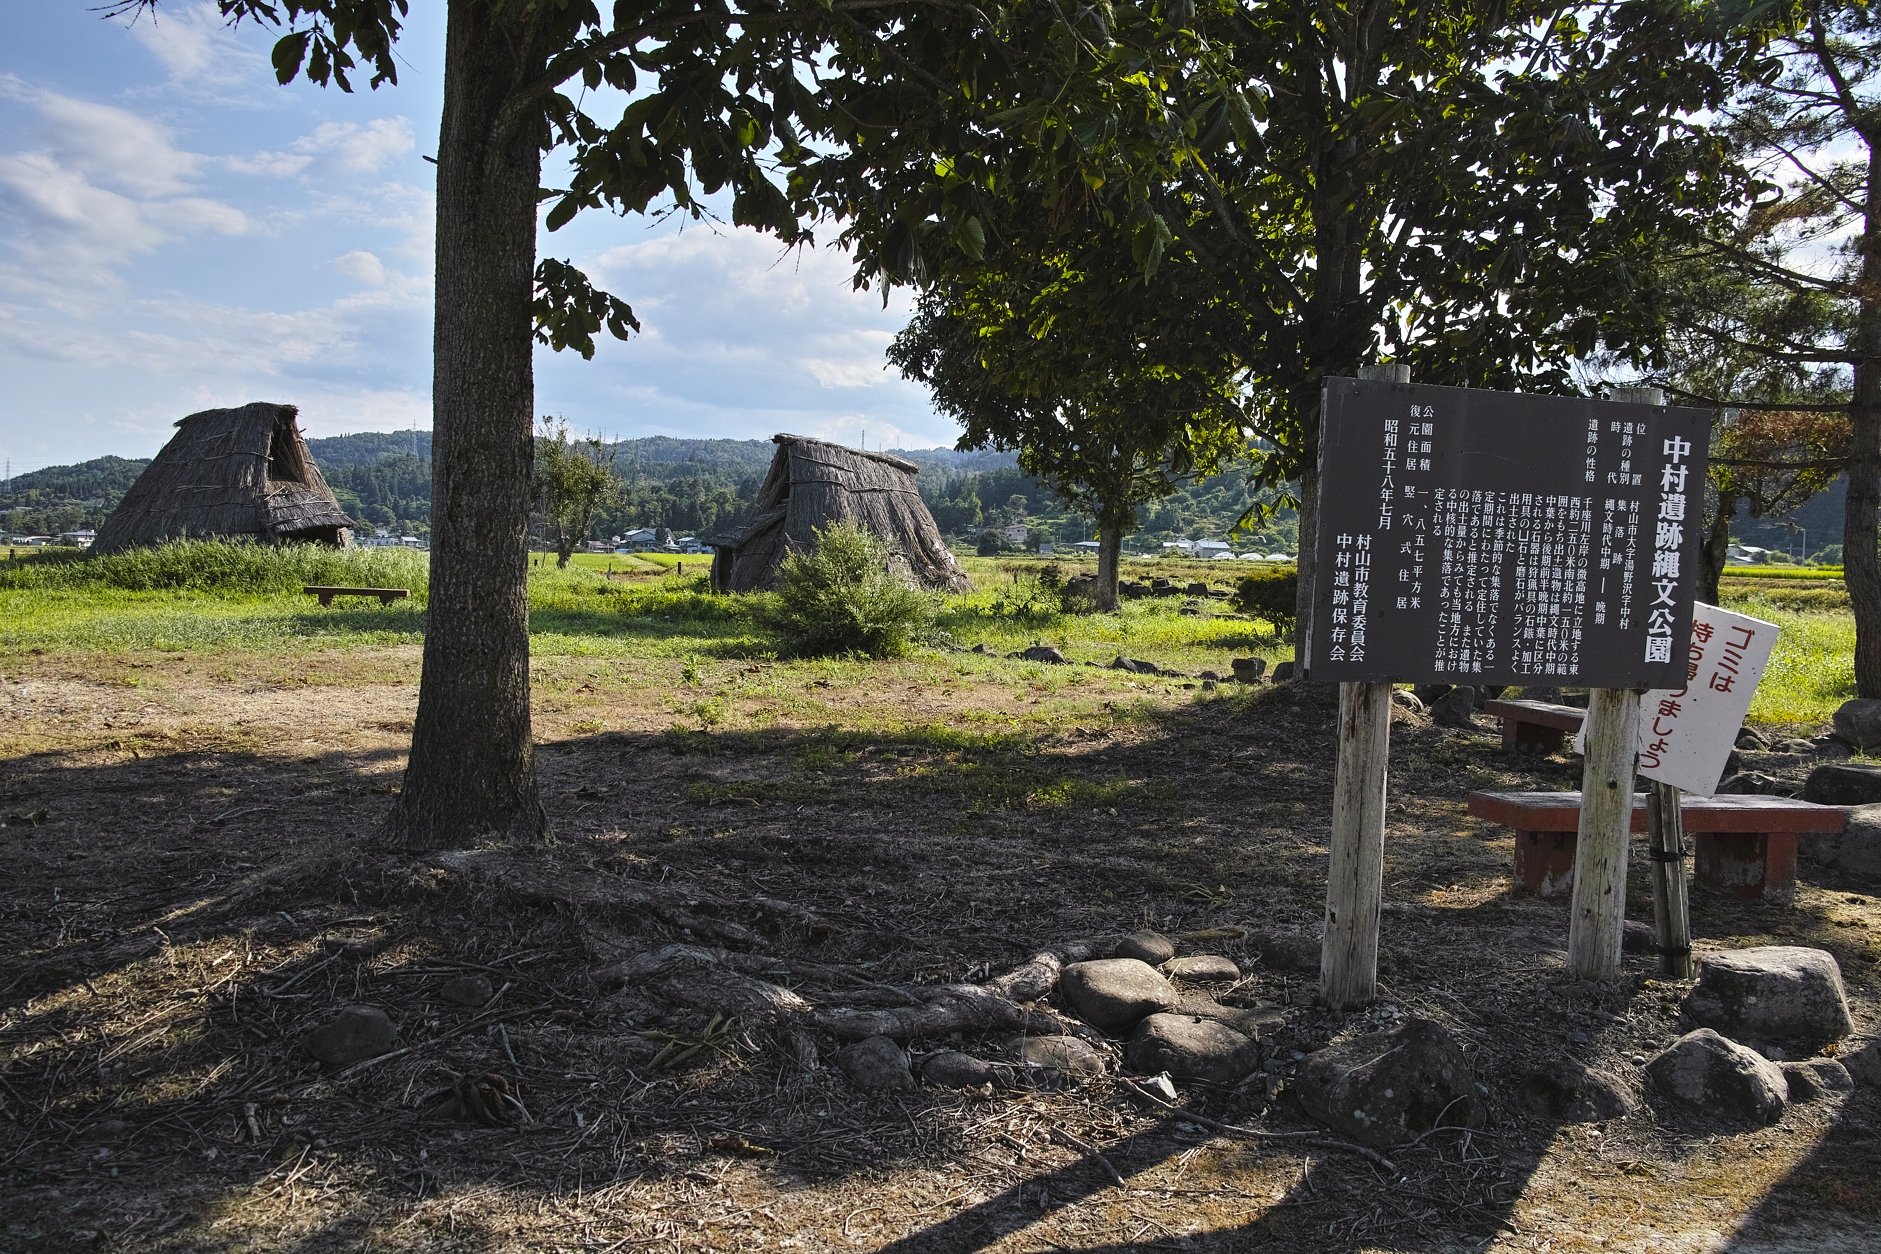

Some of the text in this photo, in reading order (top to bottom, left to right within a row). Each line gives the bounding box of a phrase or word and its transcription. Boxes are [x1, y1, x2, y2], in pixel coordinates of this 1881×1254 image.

[1406, 405, 1420, 470] 復元住居
[1420, 406, 1434, 471] 公園面積
[1585, 419, 1598, 482] 遺跡の性格
[1619, 422, 1633, 484] 遺跡の種別
[1378, 419, 1398, 529] 昭和五十八年七月
[1433, 488, 1445, 535] 定される
[1506, 493, 1519, 552] 出土された
[1619, 501, 1640, 629] 村山市大字湯野沢字中村
[1645, 436, 1691, 663] 中村遺跡縄文公園
[1330, 533, 1352, 661] 中村遺跡保存会
[1350, 534, 1372, 662] 村山市教育委員会
[1709, 625, 1755, 693] ゴミは
